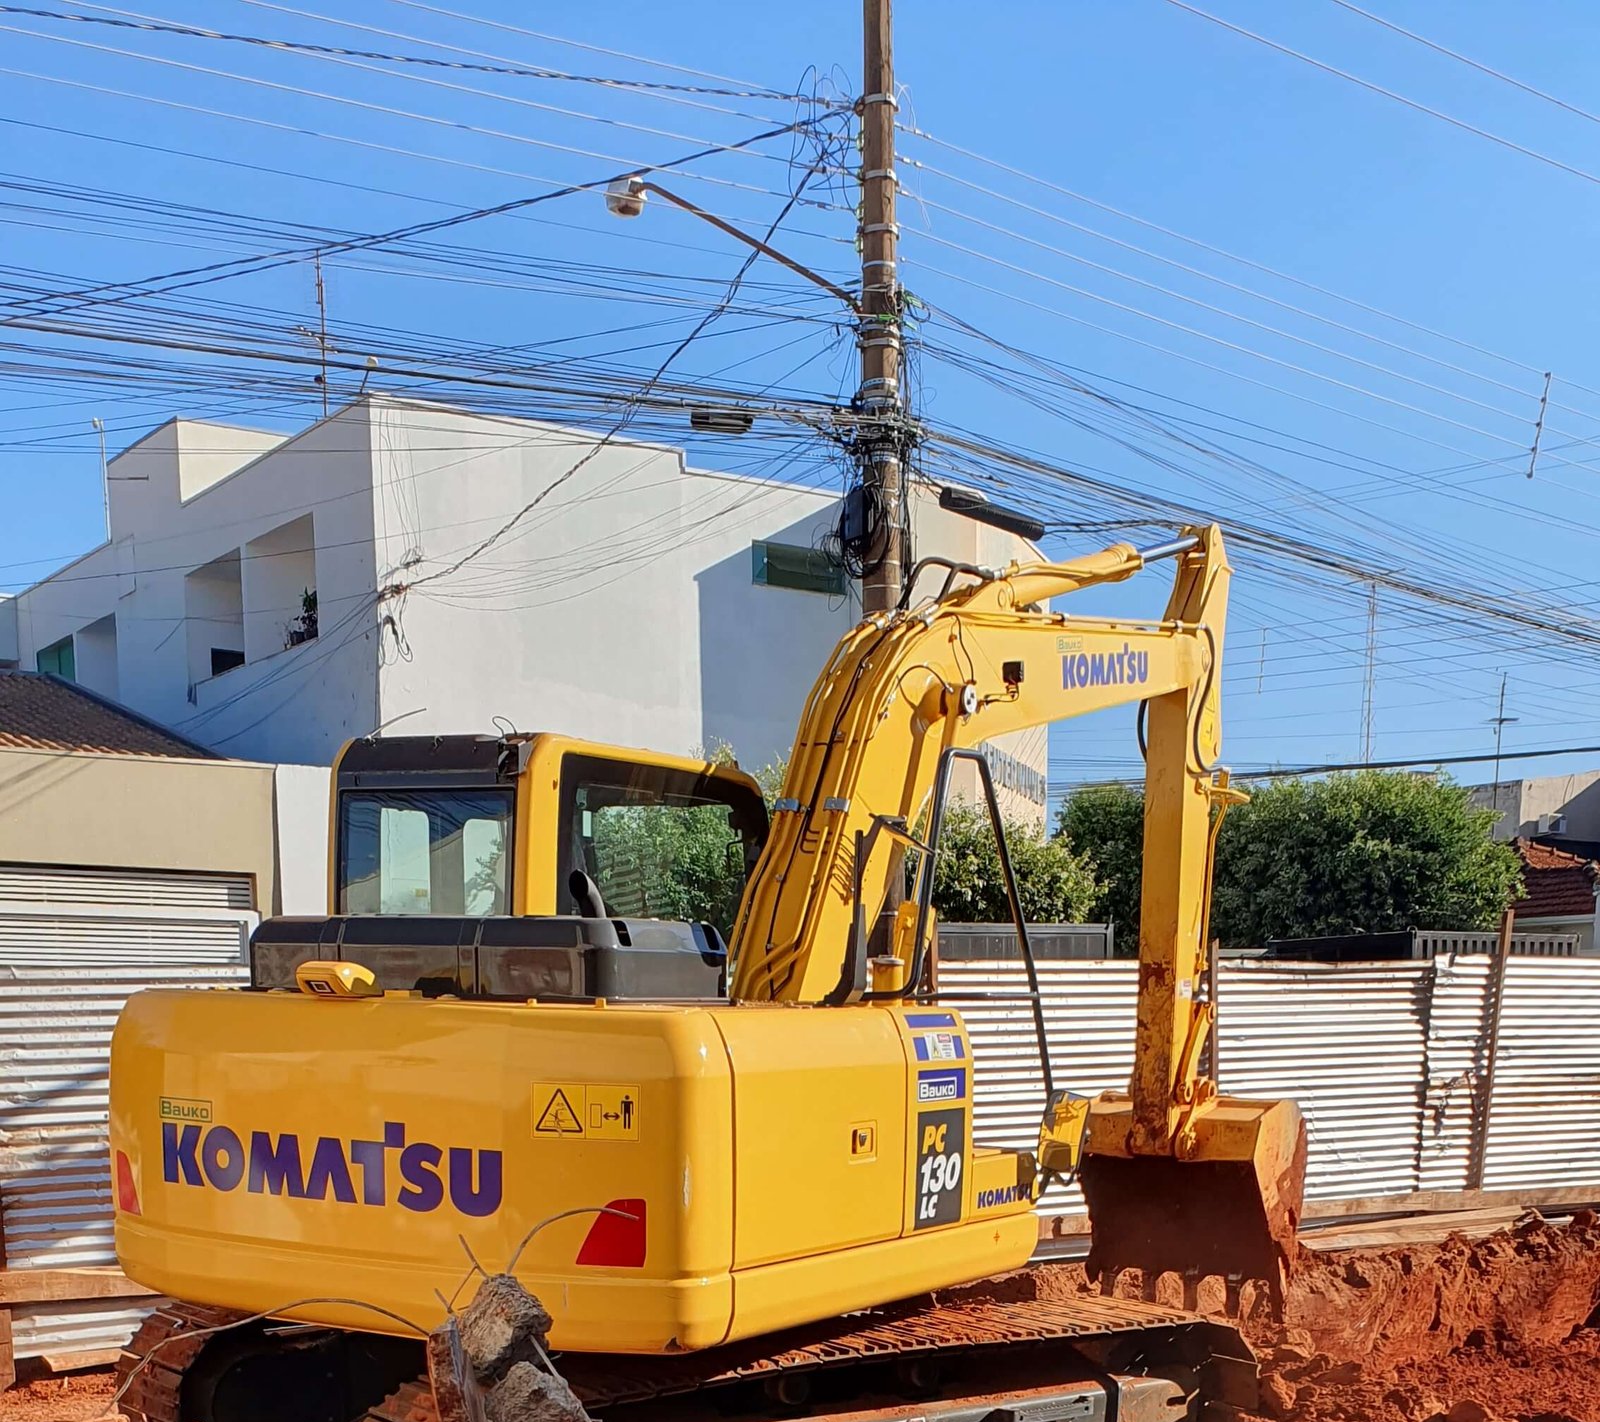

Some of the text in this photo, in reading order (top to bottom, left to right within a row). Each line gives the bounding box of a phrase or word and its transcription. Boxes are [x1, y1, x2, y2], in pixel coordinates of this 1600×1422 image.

[1062, 642, 1148, 690] KOMATSU
[920, 1083, 955, 1099] Bauko
[161, 1100, 209, 1119] Bauko
[922, 1123, 947, 1155] PC
[162, 1121, 503, 1218] KOMATSU
[921, 1152, 961, 1194] 130
[920, 1194, 938, 1220] LC
